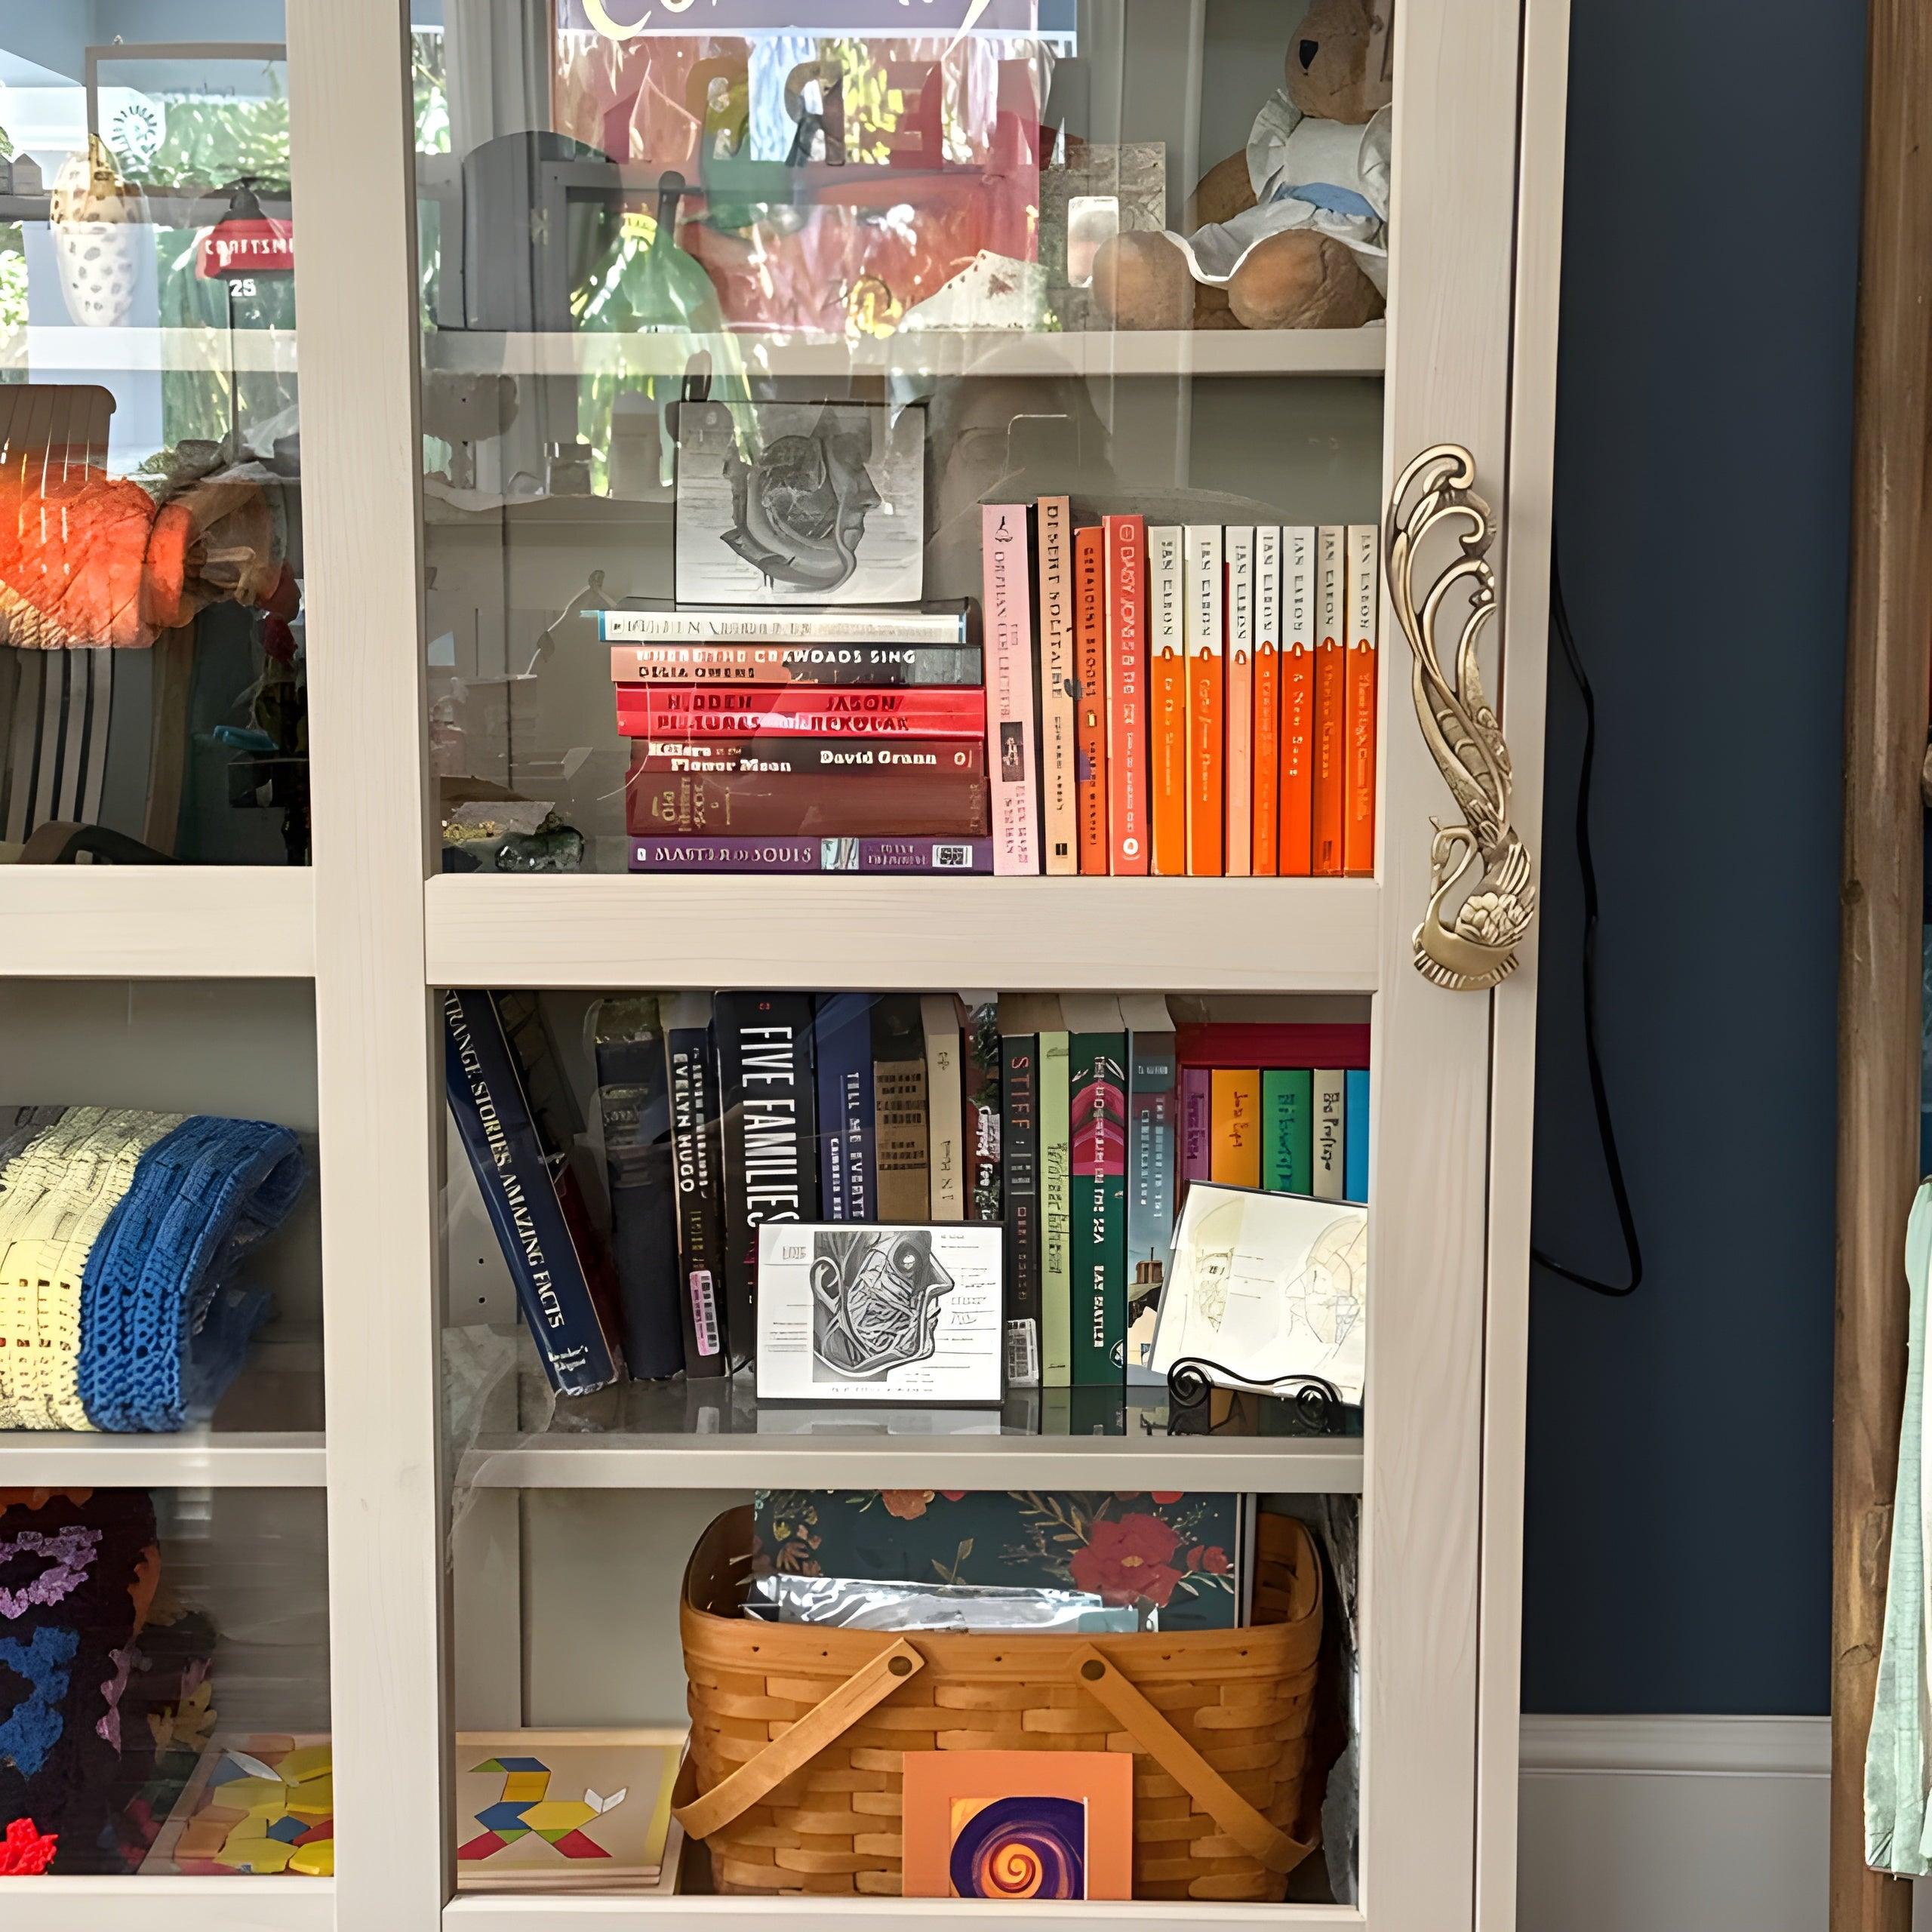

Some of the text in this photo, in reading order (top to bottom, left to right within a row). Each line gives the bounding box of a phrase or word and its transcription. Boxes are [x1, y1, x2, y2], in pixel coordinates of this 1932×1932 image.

[229, 279, 257, 297] 25
[820, 750, 873, 764] David
[740, 1026, 795, 1088] FIVE
[1010, 1057, 1030, 1130] STIFF
[497, 1172, 545, 1267] AMAZING
[533, 1270, 565, 1329] FACTS
